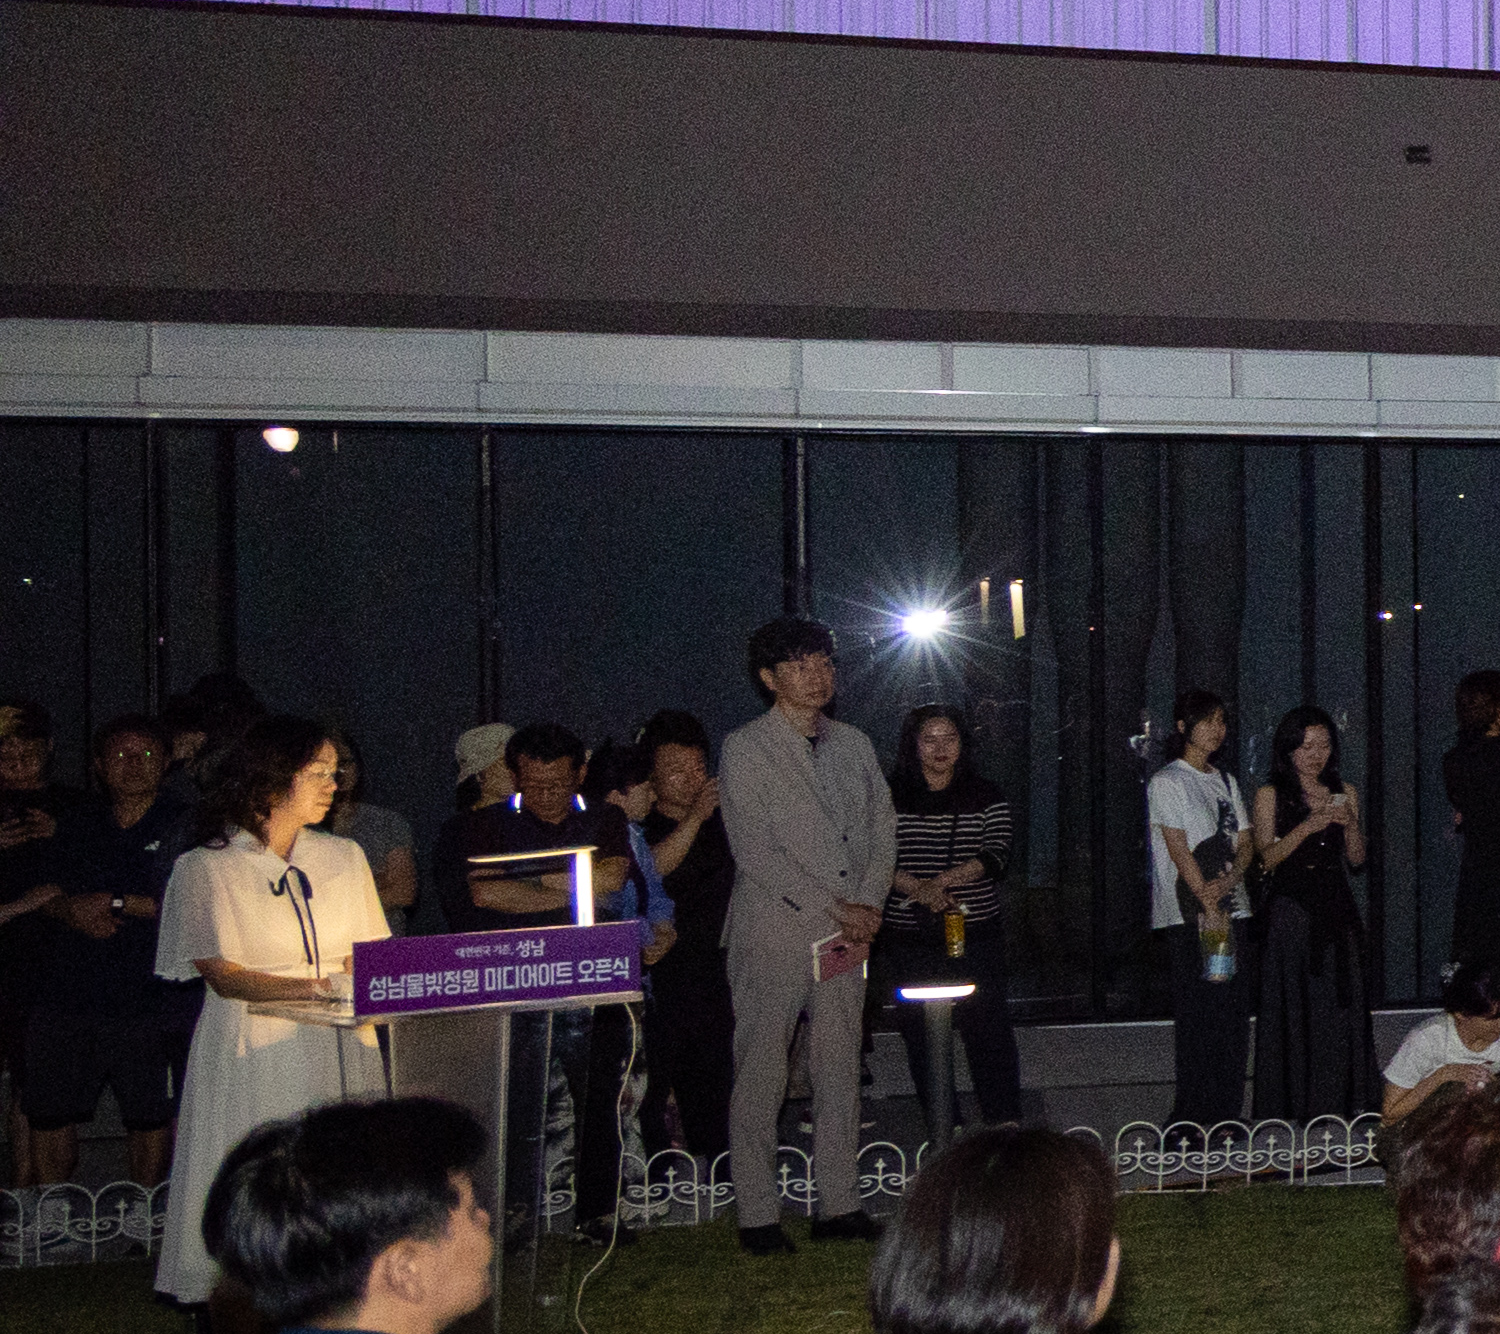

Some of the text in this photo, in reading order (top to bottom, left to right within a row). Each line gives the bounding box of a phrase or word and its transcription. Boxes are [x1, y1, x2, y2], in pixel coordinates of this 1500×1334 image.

[515, 938, 546, 959] 성남
[368, 956, 630, 1002] 성남물빛정원 미디어아트 오픈식
